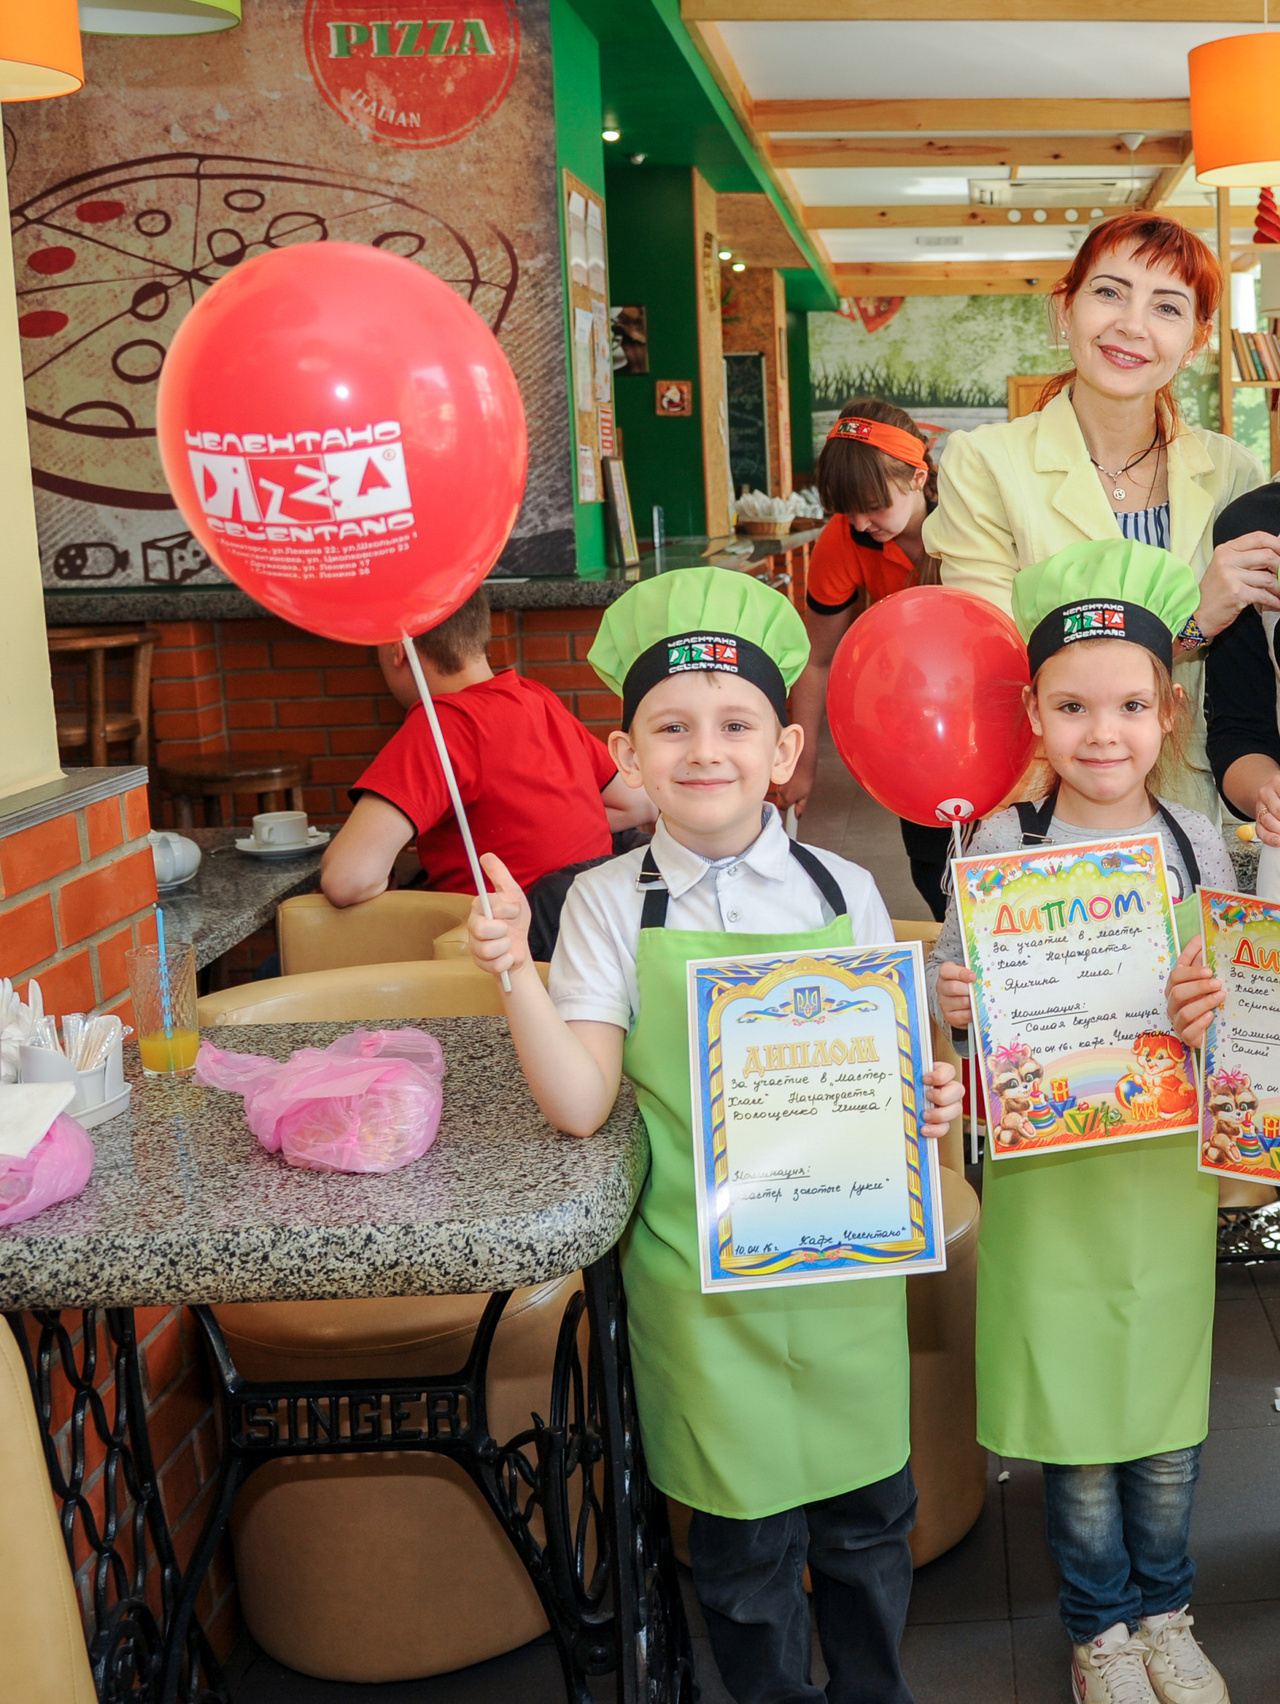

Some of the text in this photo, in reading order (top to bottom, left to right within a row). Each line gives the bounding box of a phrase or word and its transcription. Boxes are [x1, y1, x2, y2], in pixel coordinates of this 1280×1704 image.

[326, 19, 496, 58] PIZZA
[351, 89, 421, 127] ITALIAN
[184, 421, 402, 453] ЧЕЛЕНТАНО
[993, 941, 1009, 953] За
[1017, 936, 1069, 951] участие
[1230, 967, 1245, 978] За
[742, 1035, 880, 1079] ДИПЛОМ
[731, 1078, 748, 1090] За
[753, 1075, 809, 1092] участие
[246, 1392, 460, 1446] SINGER
